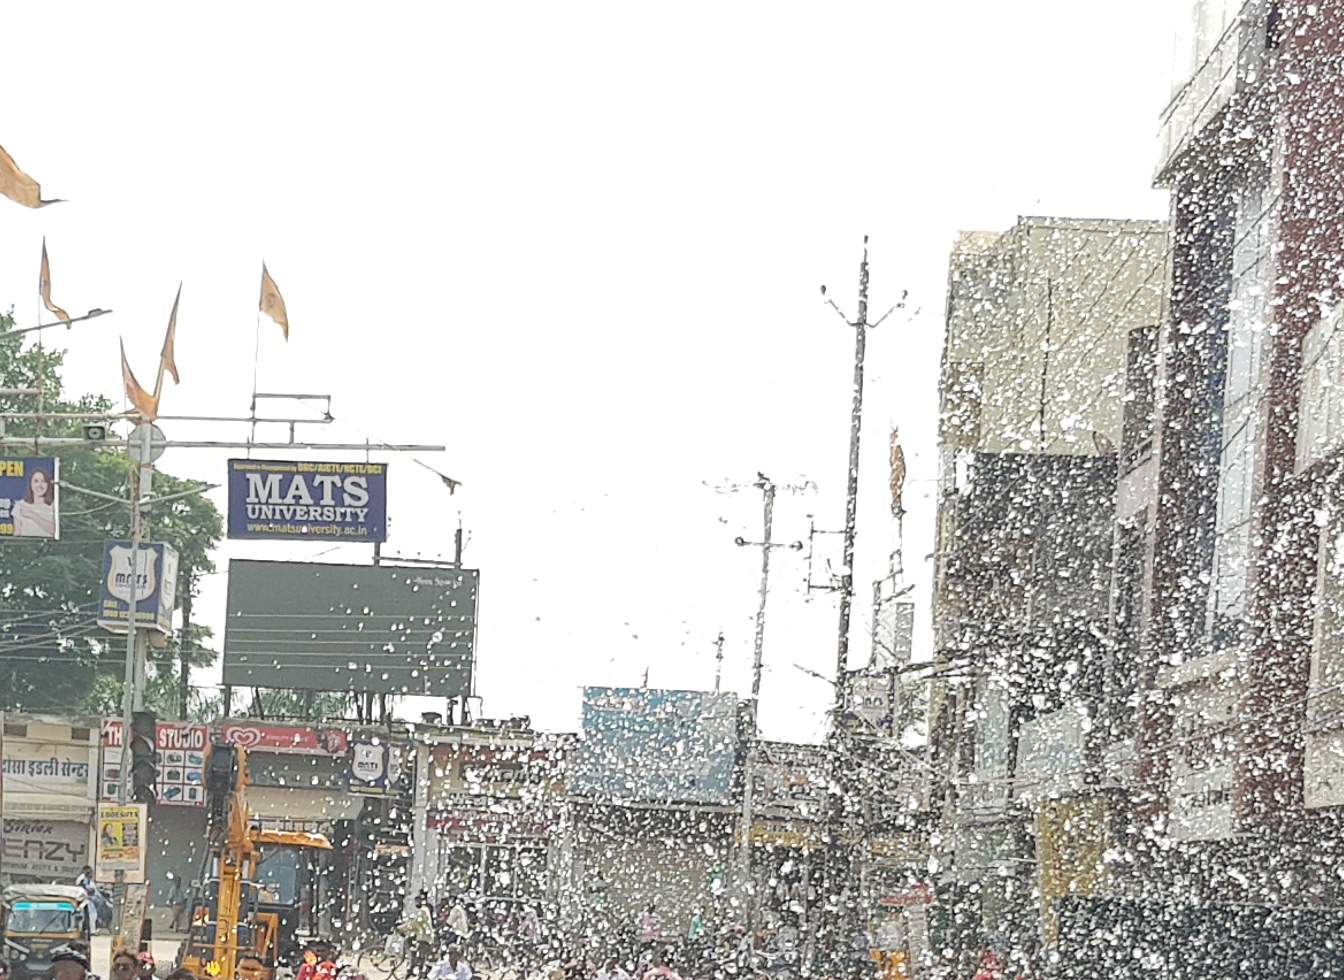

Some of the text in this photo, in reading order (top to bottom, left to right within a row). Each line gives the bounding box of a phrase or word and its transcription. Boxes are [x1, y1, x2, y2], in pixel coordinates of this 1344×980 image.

[246, 474, 369, 507] MATS
[246, 504, 369, 522] UNIVERSITY
[247, 523, 368, 536] www.matsuiversity.ac.in
[159, 728, 203, 749] STUDIO
